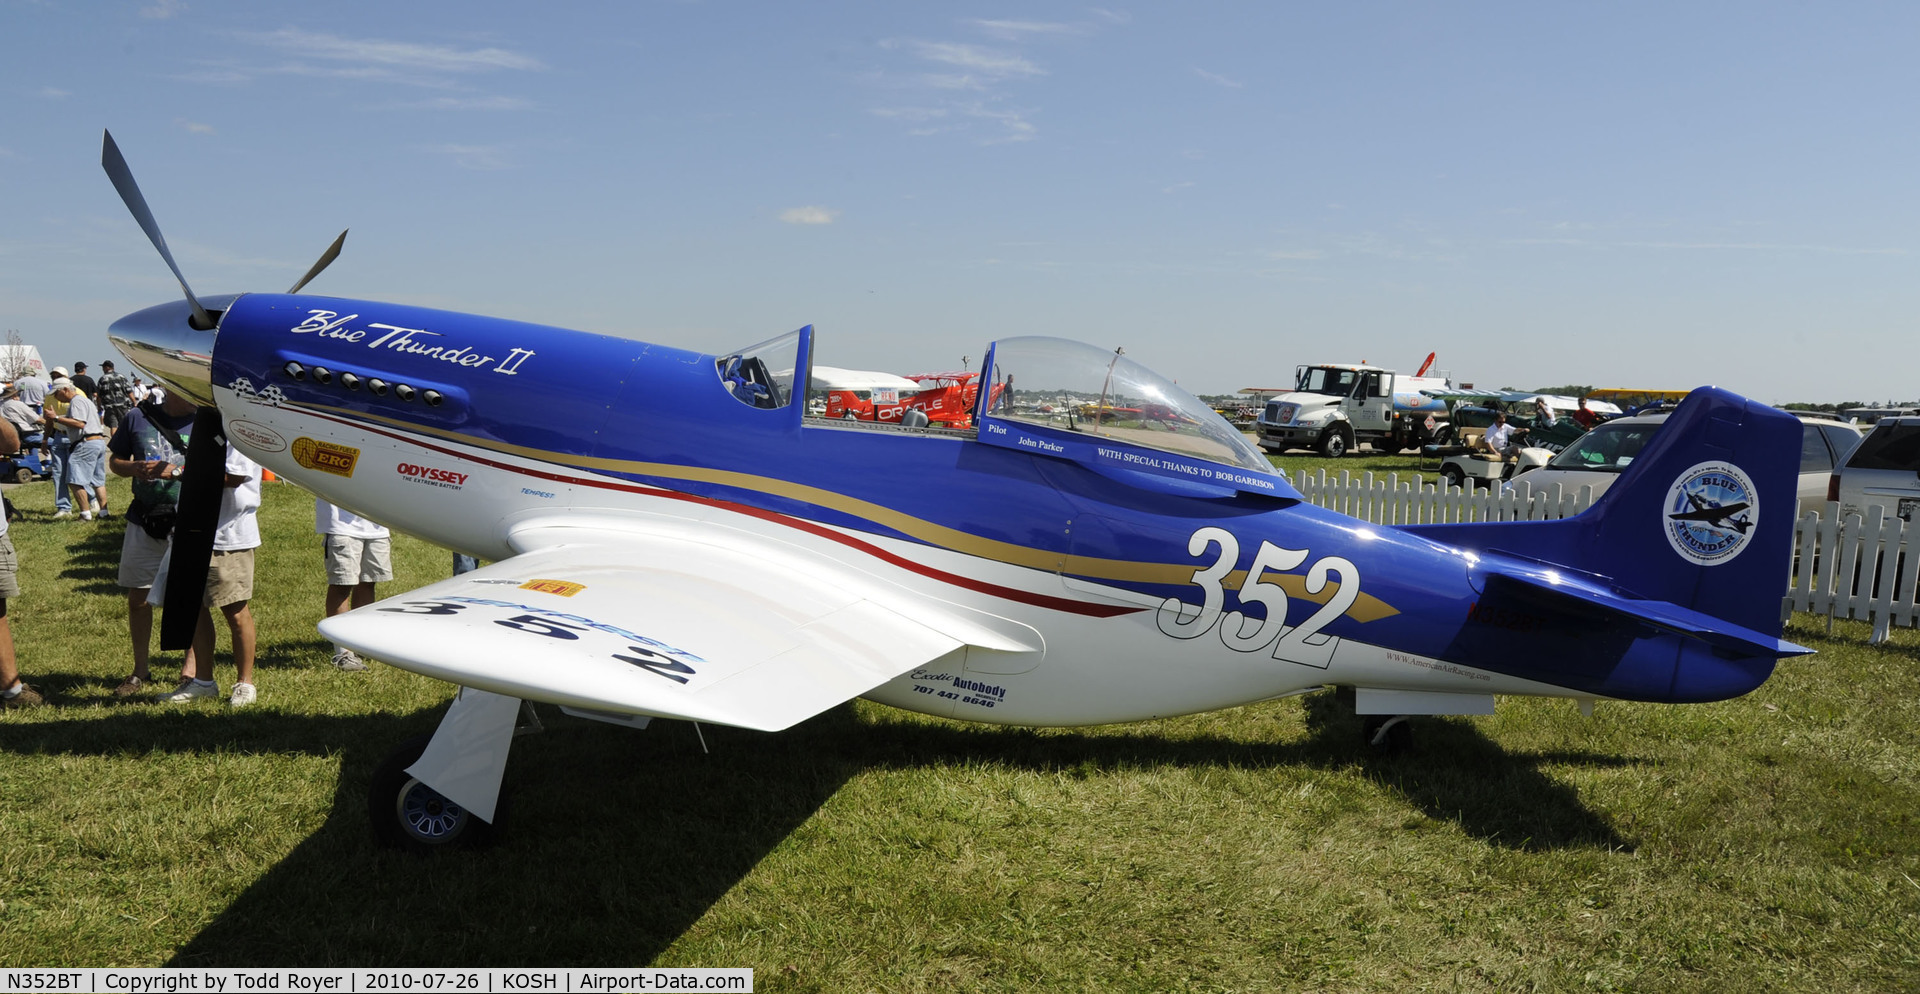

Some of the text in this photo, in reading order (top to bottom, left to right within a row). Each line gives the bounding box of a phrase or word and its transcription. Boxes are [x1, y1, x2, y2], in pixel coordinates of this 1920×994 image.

[290, 309, 536, 375] Blue Thunder II
[988, 424, 1007, 435] Pilot
[1018, 436, 1064, 453] John Parker
[316, 452, 351, 469] ERC
[1098, 447, 1275, 490] WITH SPECIAL THANKS TO BOB GARRISON
[397, 462, 469, 485] ODYSSEY
[414, 478, 438, 487] EXTREME
[439, 482, 462, 491] BATTERY
[1701, 477, 1738, 493] BLUE
[521, 487, 555, 499] TEMPEST
[1678, 521, 1736, 552] THUNDER
[1156, 526, 1361, 670] 352
[911, 669, 1006, 697] Exotic Autobody
[913, 684, 995, 708] 707 447 8646
